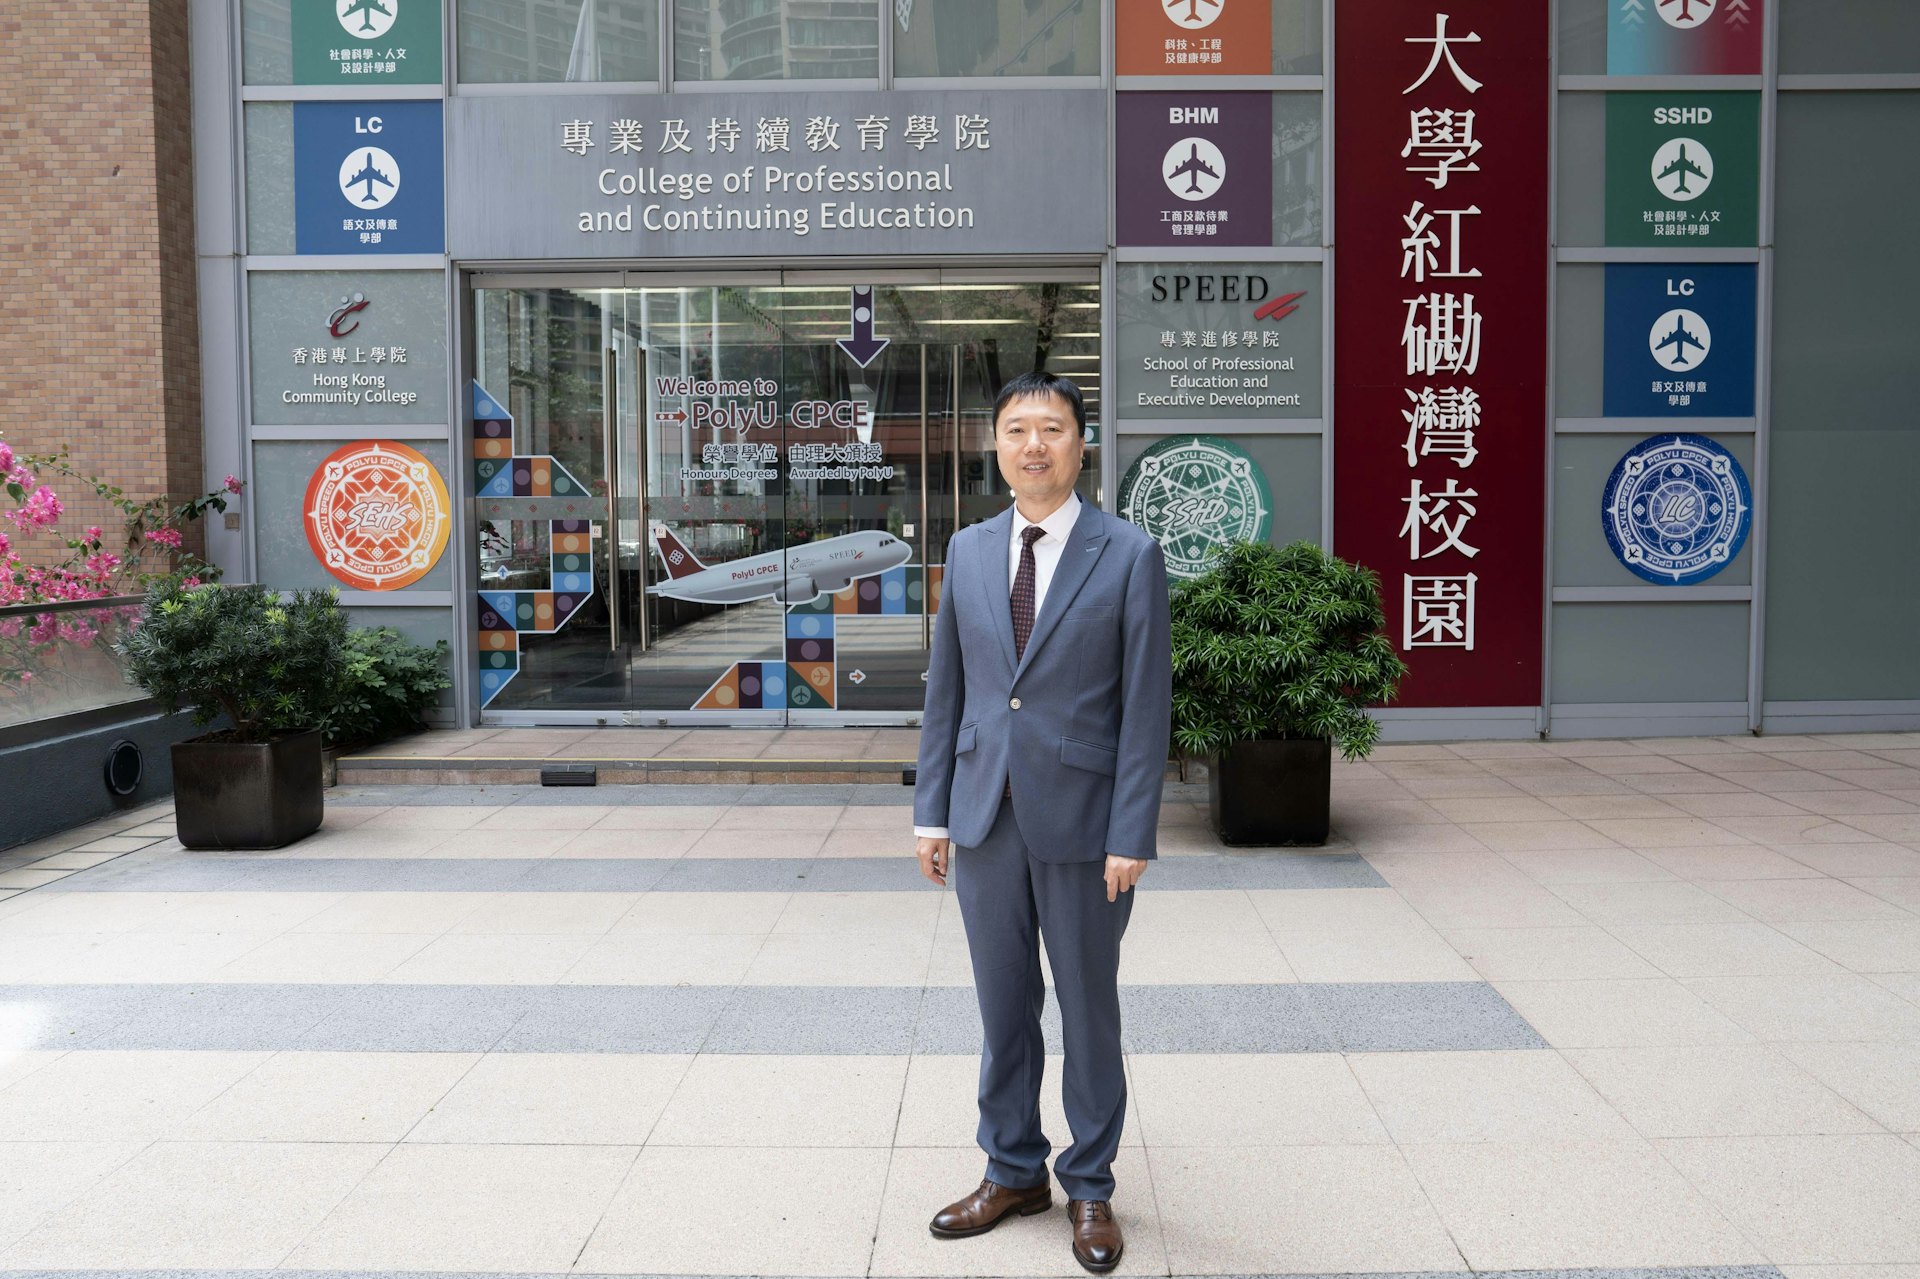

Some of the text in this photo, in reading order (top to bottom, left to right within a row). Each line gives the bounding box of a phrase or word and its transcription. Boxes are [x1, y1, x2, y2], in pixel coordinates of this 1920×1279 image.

[1164, 38, 1222, 50] 科技、工程
[329, 47, 407, 61] 社會科學、人文
[341, 62, 396, 74] 及設計學部
[1169, 107, 1219, 124] BHM
[1653, 107, 1713, 125] SSHD
[355, 116, 383, 134] LC
[598, 164, 953, 200] College of Professional
[579, 202, 975, 236] and Continuing Education
[1643, 210, 1721, 222] 社會科學、人文
[343, 219, 398, 231] 語文及傳意
[1171, 223, 1217, 236] 管理學部
[1654, 224, 1710, 236] 及設計學部
[360, 232, 382, 244] 學部
[1152, 274, 1269, 302] SPEED
[1667, 279, 1695, 296] LC
[1160, 330, 1279, 348] 專業進修學院
[1400, 12, 1483, 652] 大學紅磡灣校園
[292, 346, 407, 365] 香港專上學院
[1143, 357, 1294, 371] School of Professional
[313, 373, 385, 390] Hong Kong
[657, 376, 777, 397] Welcome to
[1170, 375, 1268, 388] Education and
[1651, 381, 1707, 393] 語文及傳意
[282, 389, 417, 406] Community College
[1138, 392, 1300, 409] Executive Development
[1668, 395, 1690, 407] 學部
[692, 400, 869, 435] PolyU CPCE
[346, 457, 408, 472] POLYU CPCE
[1163, 452, 1228, 467] POLYU CPCE
[1647, 451, 1709, 466] POLYU CPCE
[681, 466, 893, 482] Honours Degrees Awarded by PolyU
[321, 482, 335, 514] SPEED
[1134, 478, 1151, 510] SPEED
[1620, 477, 1635, 510] SPEED
[345, 501, 414, 531] SEHS
[1158, 498, 1229, 528] SSHD
[1658, 494, 1697, 524] LC
[829, 549, 857, 560] SPEED
[732, 564, 779, 581] PolyU CPCE
